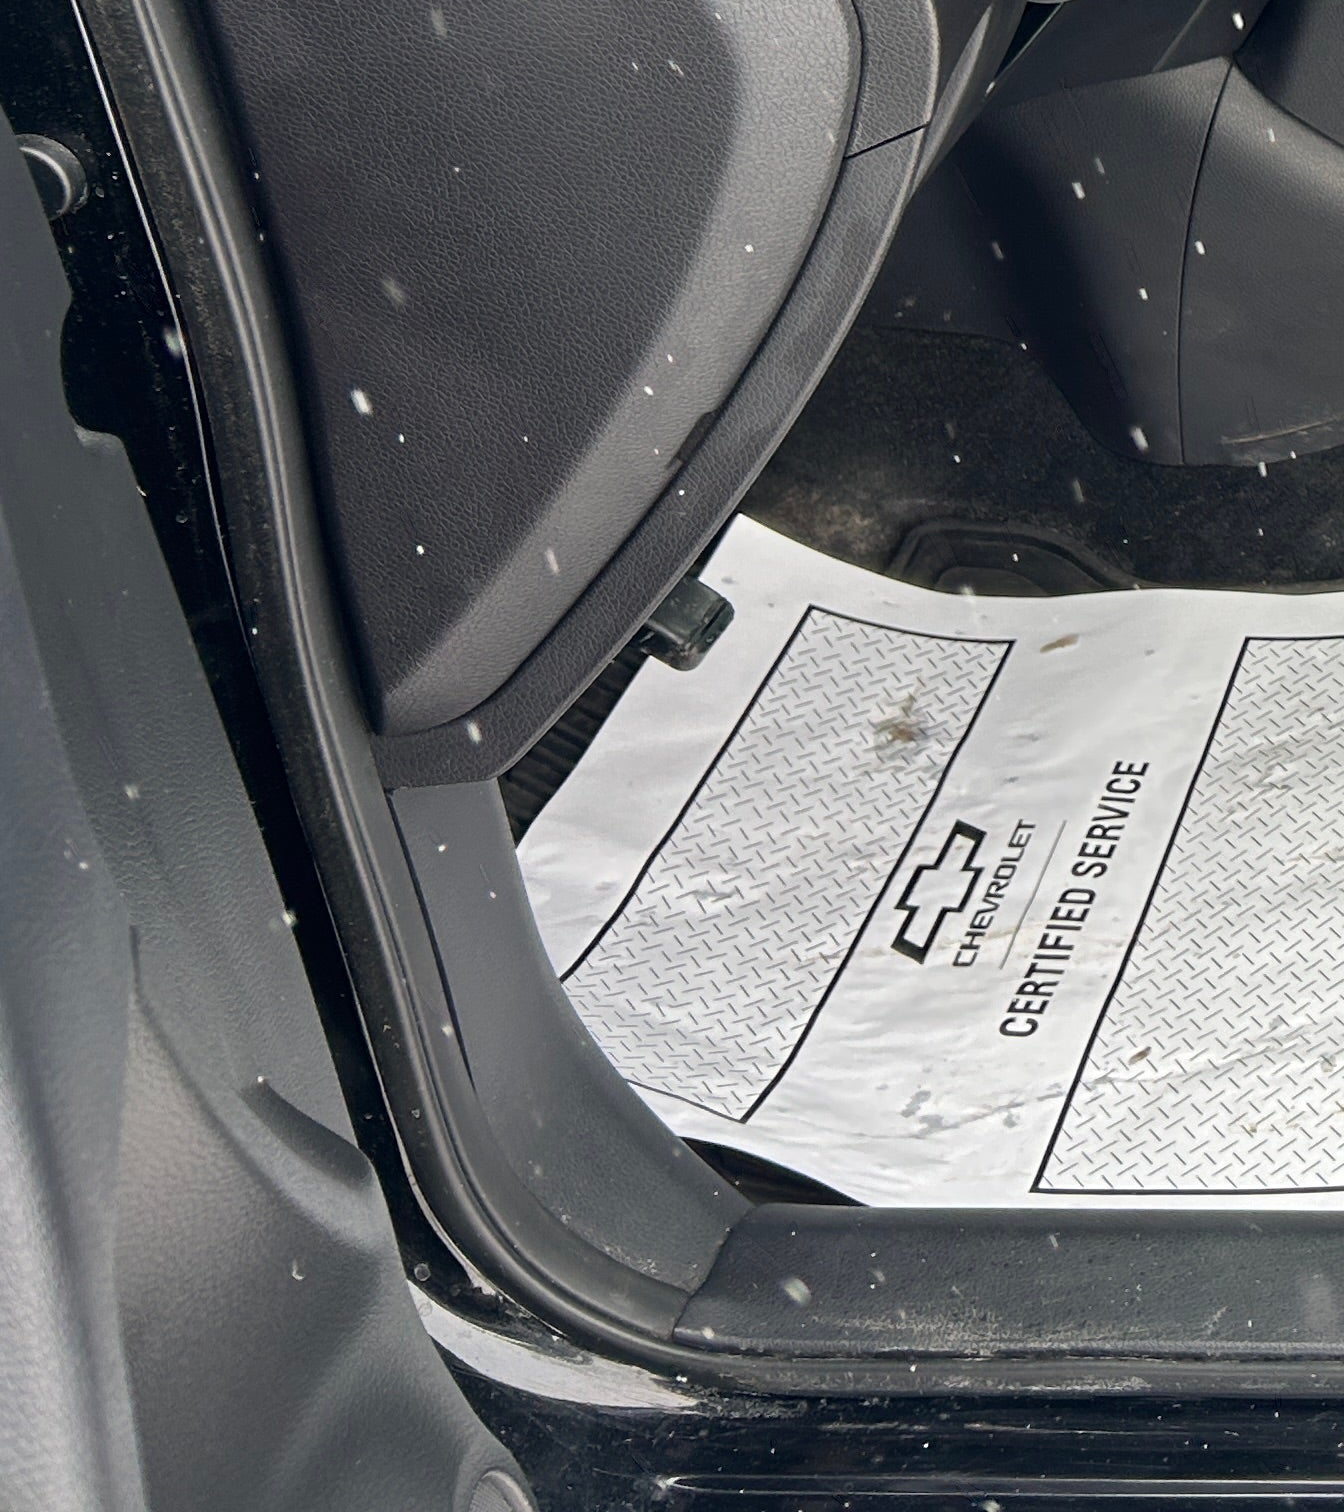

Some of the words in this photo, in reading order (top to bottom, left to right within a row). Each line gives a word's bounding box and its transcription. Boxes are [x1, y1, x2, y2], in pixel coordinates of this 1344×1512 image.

[952, 818, 1036, 967] CHEVROLET
[1000, 888, 1096, 1037] CERTIFIED
[1071, 760, 1150, 878] SERVICE
